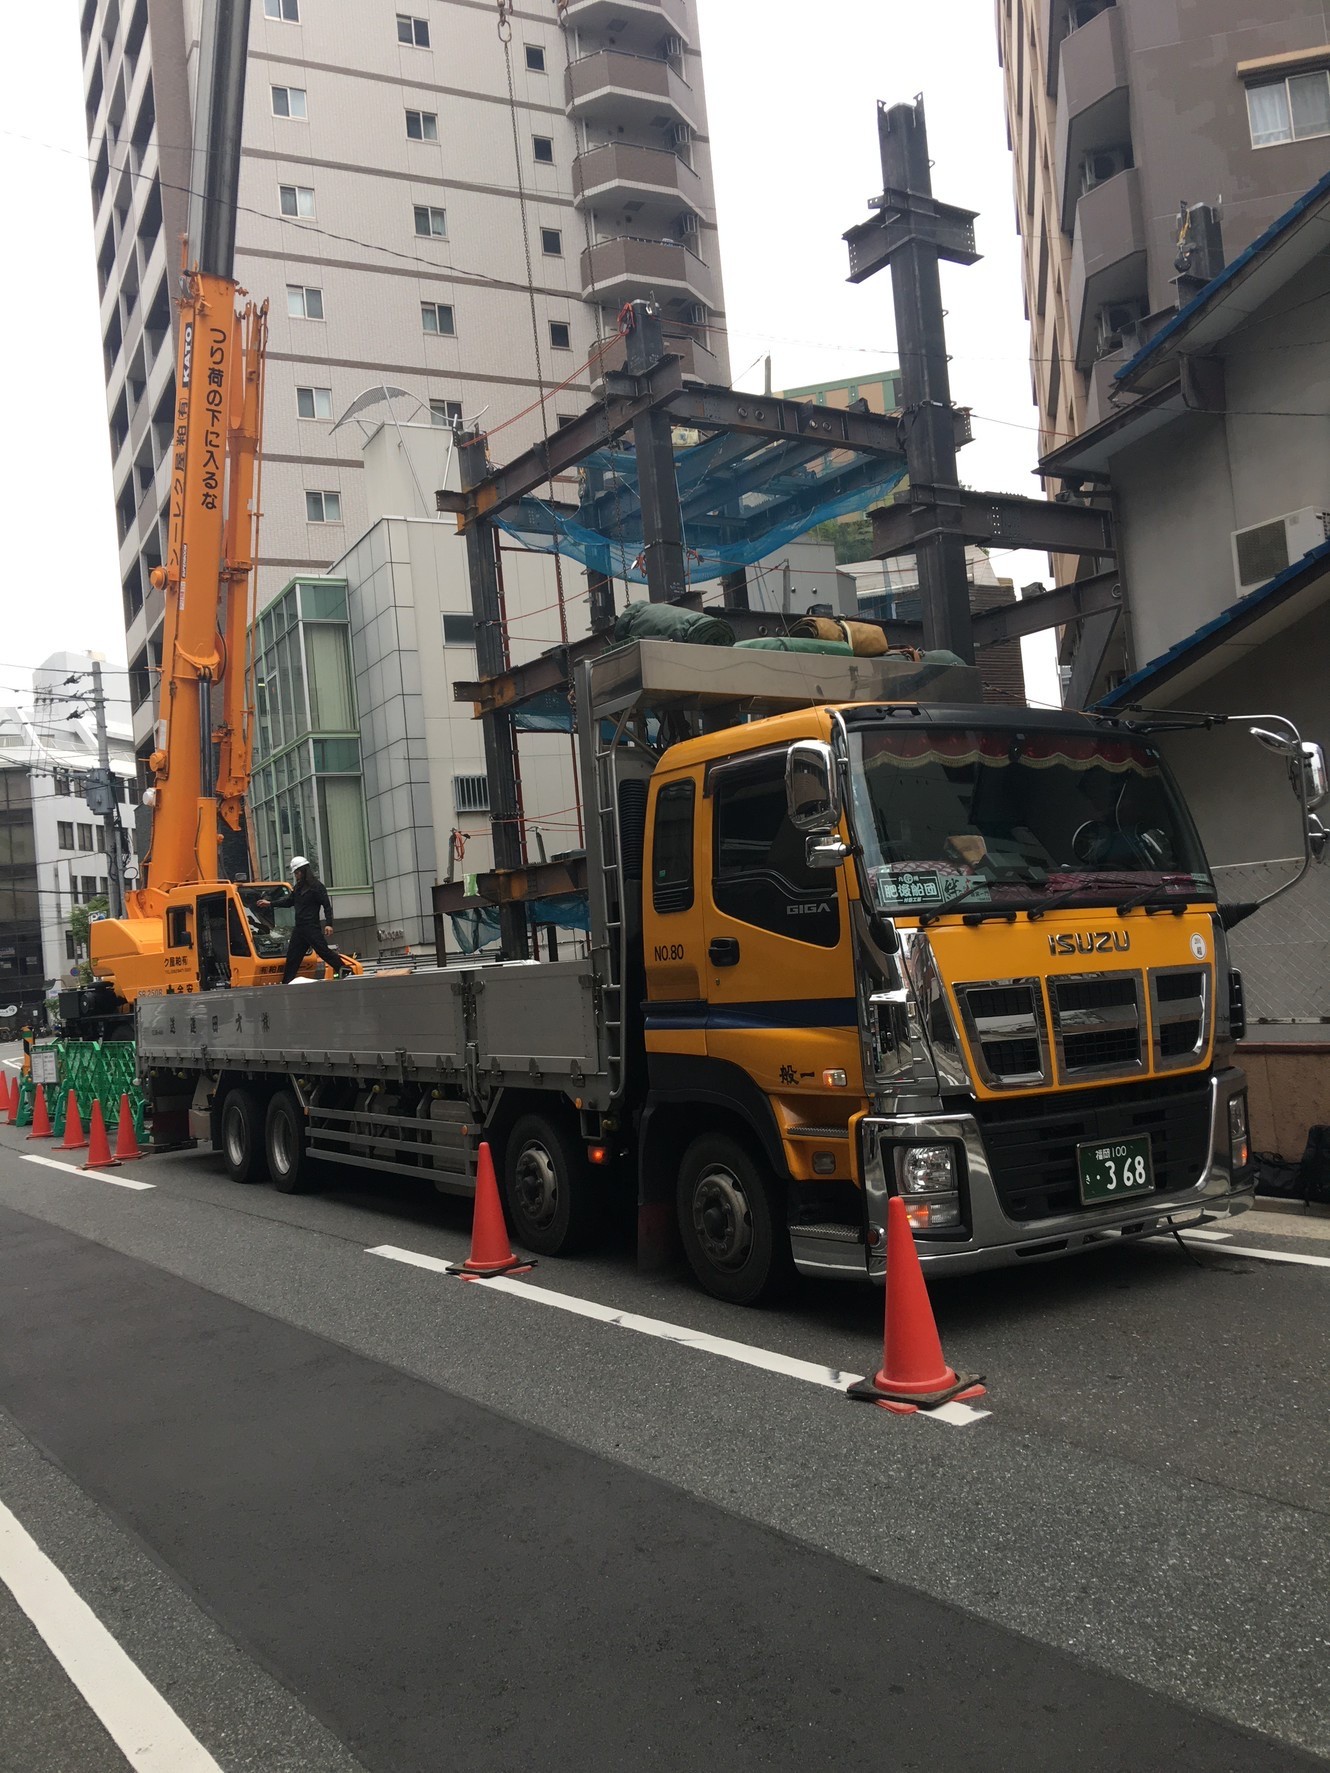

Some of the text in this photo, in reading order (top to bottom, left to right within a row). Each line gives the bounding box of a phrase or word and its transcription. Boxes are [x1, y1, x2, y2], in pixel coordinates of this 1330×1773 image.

[183, 327, 192, 382] KATO
[202, 328, 226, 509] つり荷の下に入るな
[787, 903, 831, 915] GIGA
[654, 944, 684, 961] NO.80
[1047, 930, 1130, 956] ISUZU
[1095, 1145, 1127, 1160] 福岡 100
